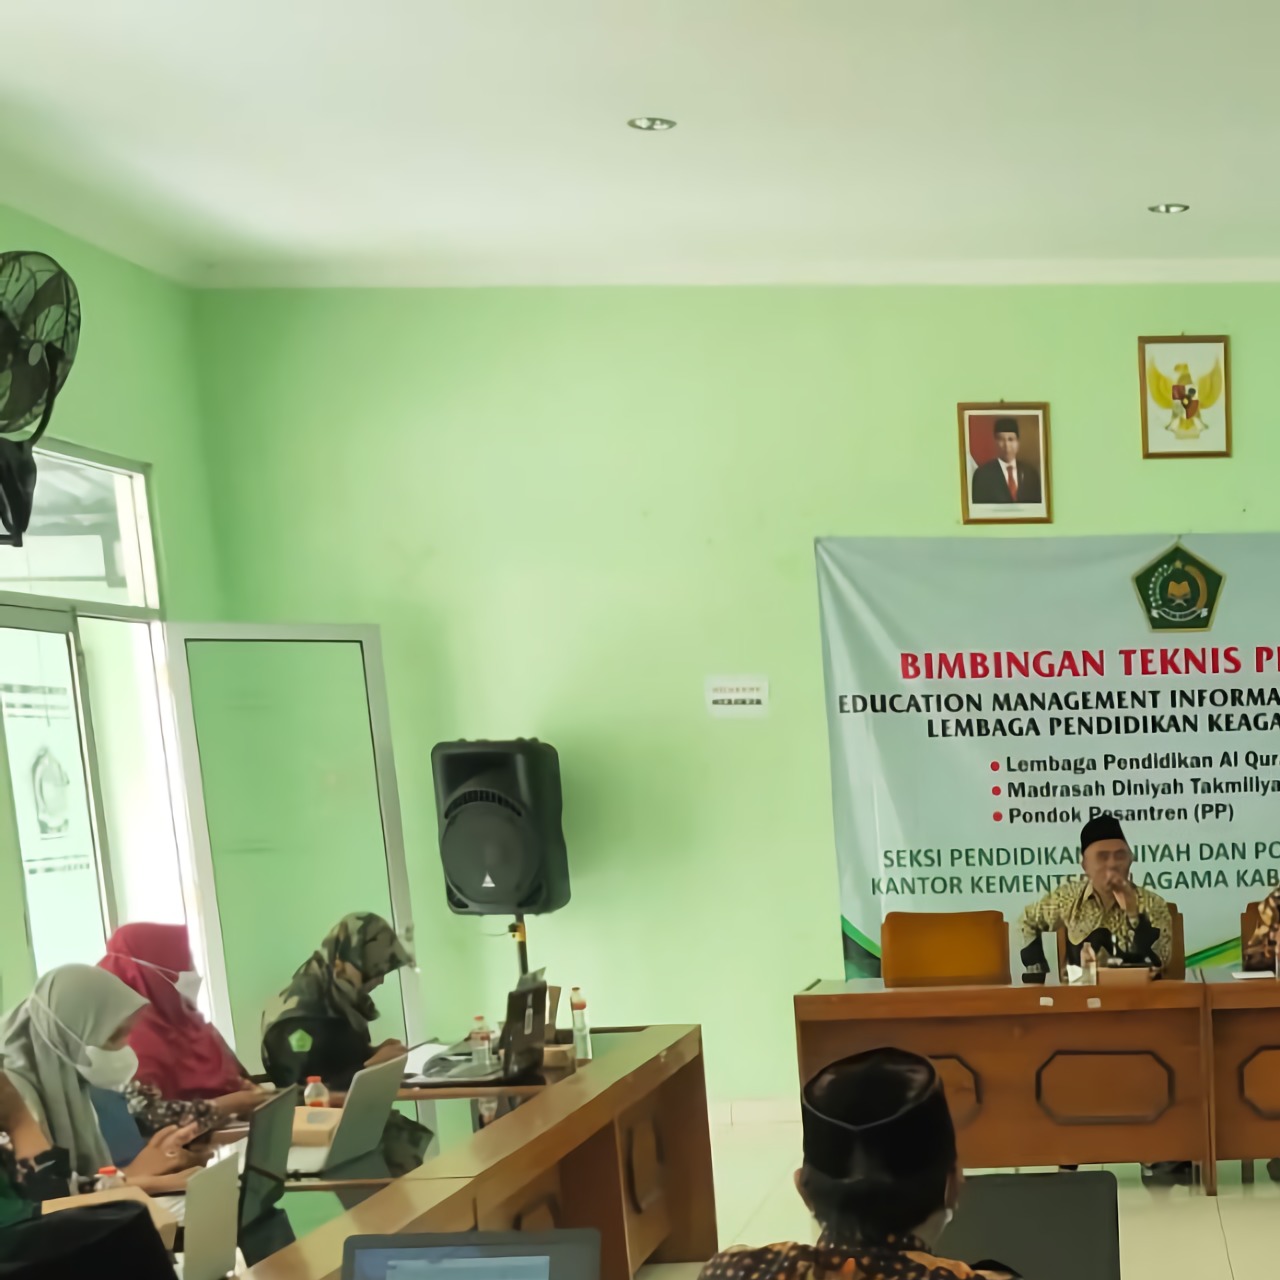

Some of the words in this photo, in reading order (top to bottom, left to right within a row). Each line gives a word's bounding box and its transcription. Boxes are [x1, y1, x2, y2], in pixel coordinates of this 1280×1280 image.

[901, 650, 1104, 679] BIMBINGAN
[1119, 647, 1241, 675] TEKNIS
[839, 693, 982, 713] EDUCATION
[992, 690, 1161, 712] MANAGEMENT
[928, 717, 1040, 738] LEMBAGA
[1050, 714, 1198, 736] PENDIDIKAN
[1006, 756, 1097, 774] Lembaga
[1103, 752, 1213, 771] Pendidikan
[1219, 750, 1238, 768] Al
[1007, 780, 1105, 798] Madrasah
[1112, 778, 1184, 799] Diniyah
[1008, 806, 1082, 824] Pondok
[1194, 803, 1234, 823] (PP)
[883, 849, 942, 868] SEKSI
[950, 846, 1083, 867] PENDIDIKA
[1130, 843, 1191, 864] IYAH
[1199, 842, 1246, 861] DAN
[871, 876, 962, 896] KANTOR
[971, 872, 1133, 895] KEMENT
[1142, 869, 1229, 891] AGAMA
